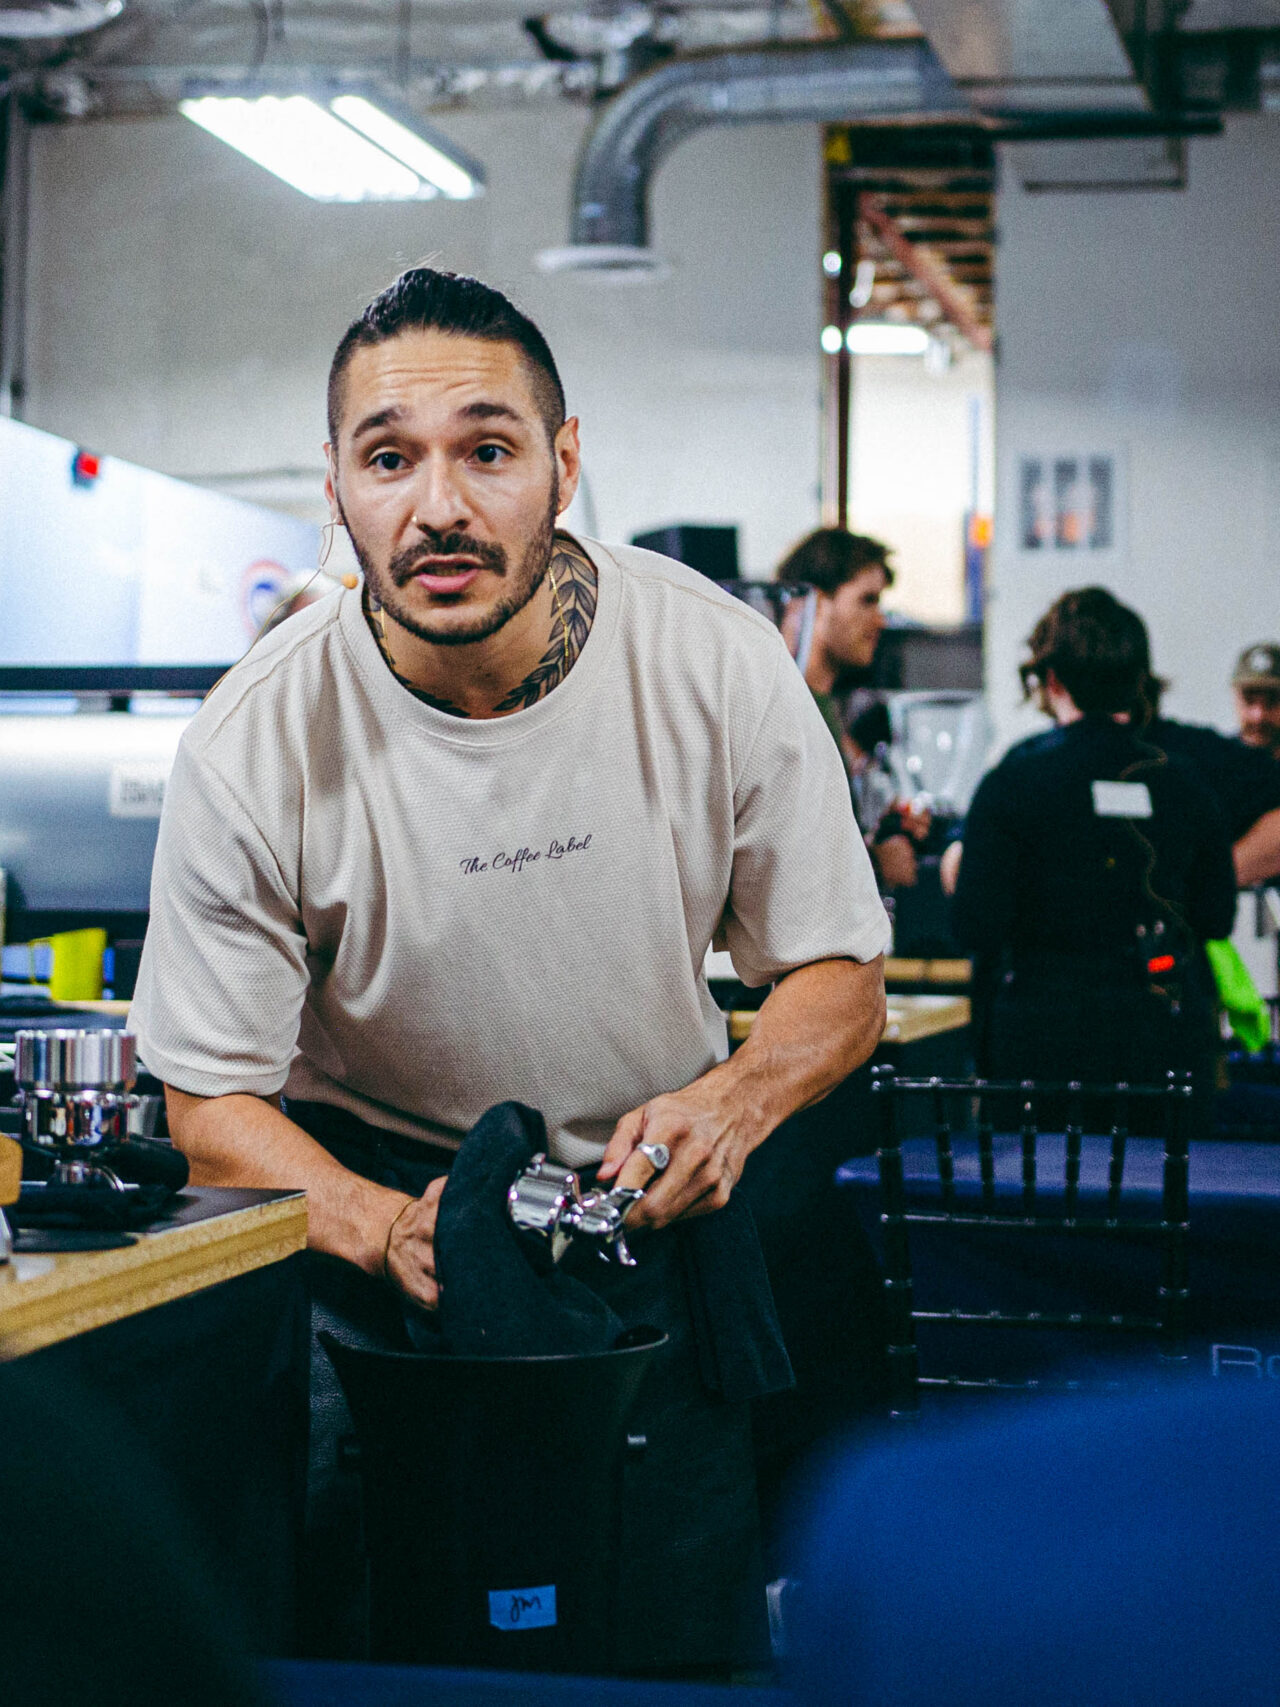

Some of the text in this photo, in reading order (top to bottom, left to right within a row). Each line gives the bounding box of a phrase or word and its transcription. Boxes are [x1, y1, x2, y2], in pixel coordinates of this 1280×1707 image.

[460, 834, 592, 874] The Coffee Label
